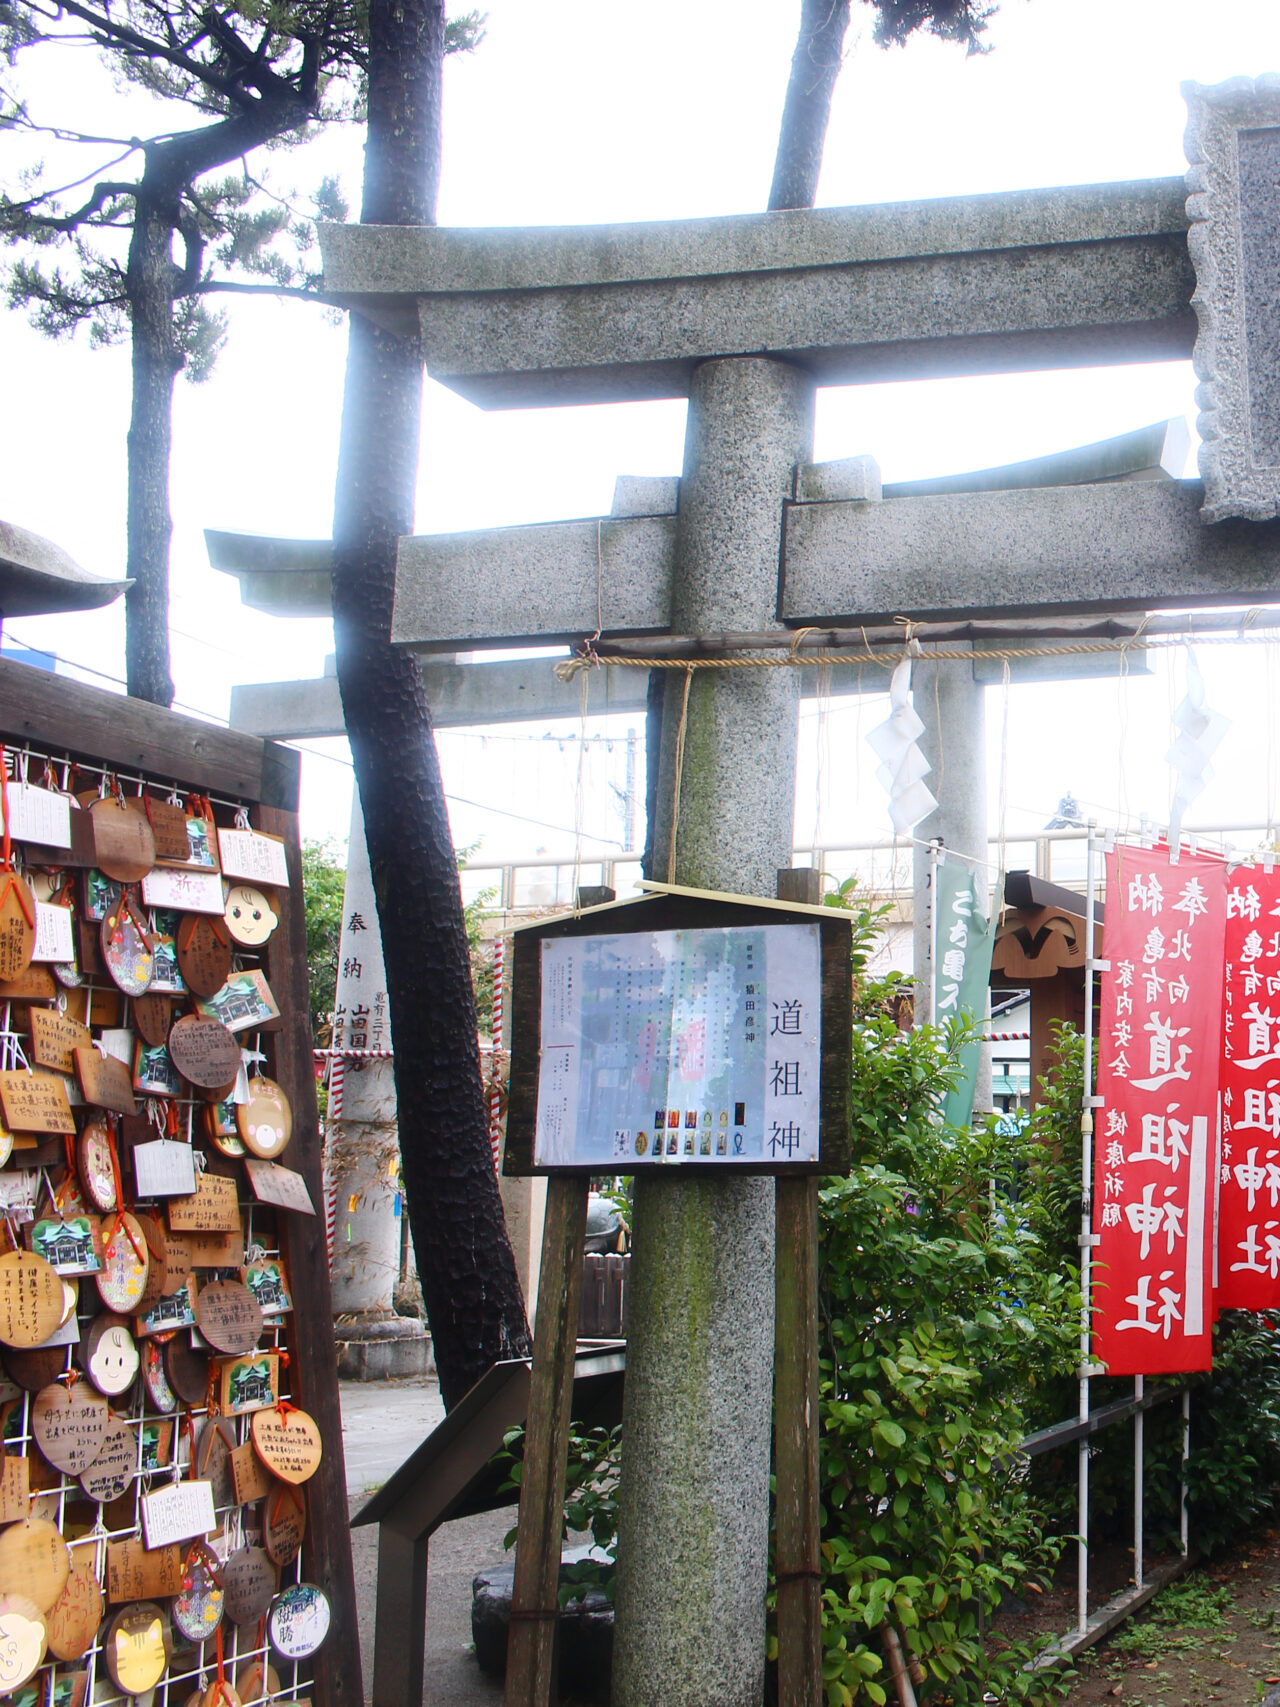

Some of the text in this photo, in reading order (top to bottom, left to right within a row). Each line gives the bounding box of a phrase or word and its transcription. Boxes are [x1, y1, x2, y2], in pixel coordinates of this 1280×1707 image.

[343, 912, 367, 979] 奉納
[767, 998, 802, 1158] 道祖神
